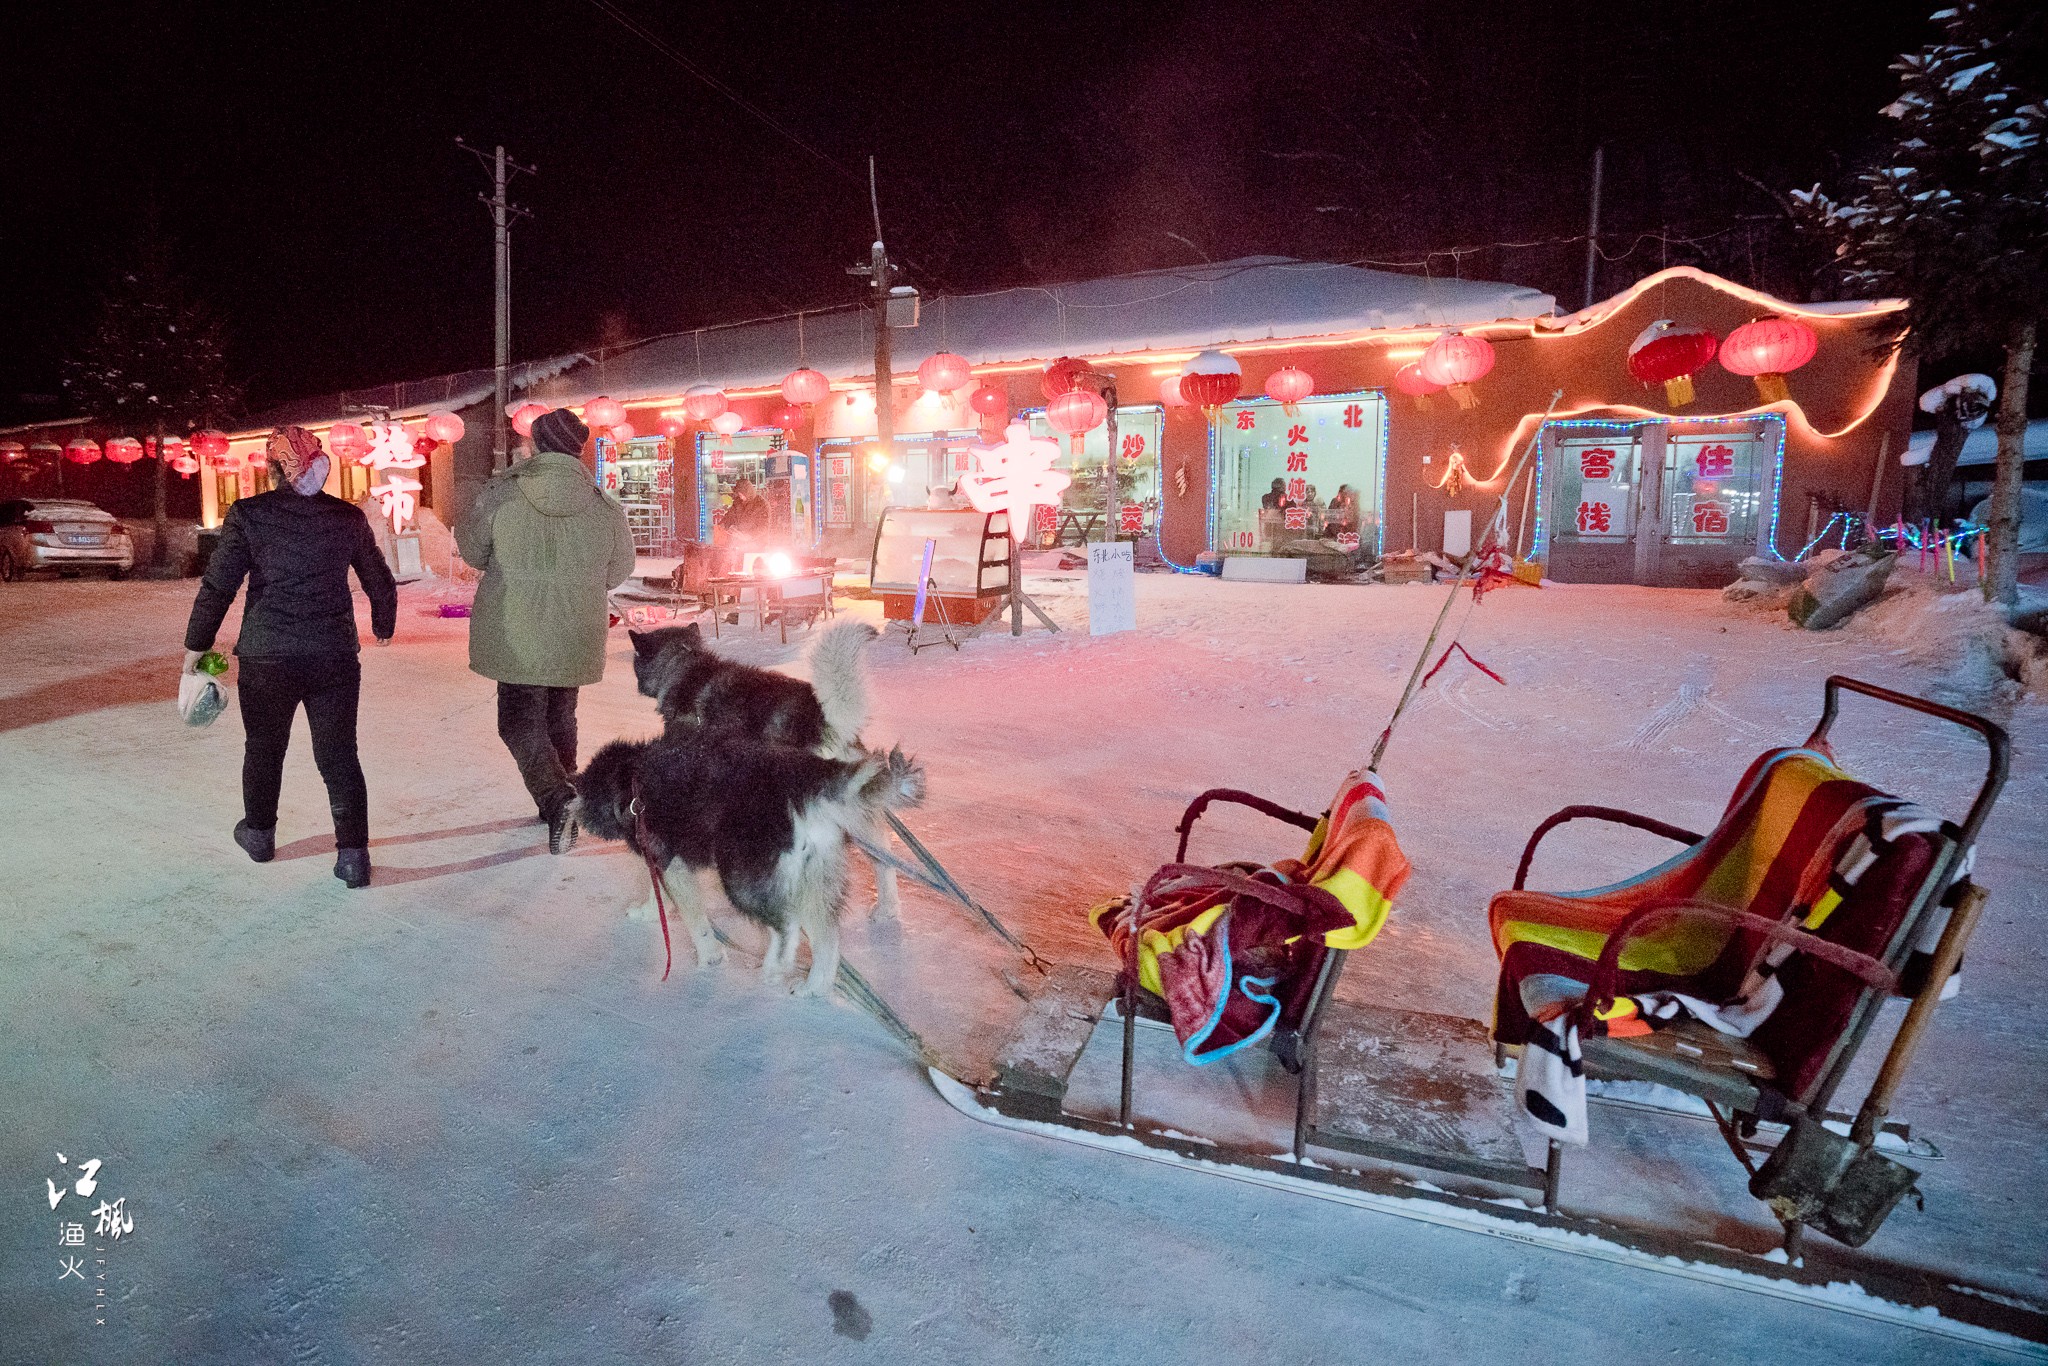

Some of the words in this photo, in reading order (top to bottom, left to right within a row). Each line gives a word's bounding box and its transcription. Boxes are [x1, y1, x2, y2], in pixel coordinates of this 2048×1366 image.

[1236, 410, 1256, 430] 东
[1343, 404, 1364, 428] 北
[360, 423, 427, 536] 超市
[1120, 434, 1145, 533] 炒菜
[1285, 424, 1309, 529] 火炕炖菜
[1576, 447, 1616, 533] 客栈
[1693, 445, 1733, 533] 住宿
[1092, 548, 1132, 564] 东北小吃
